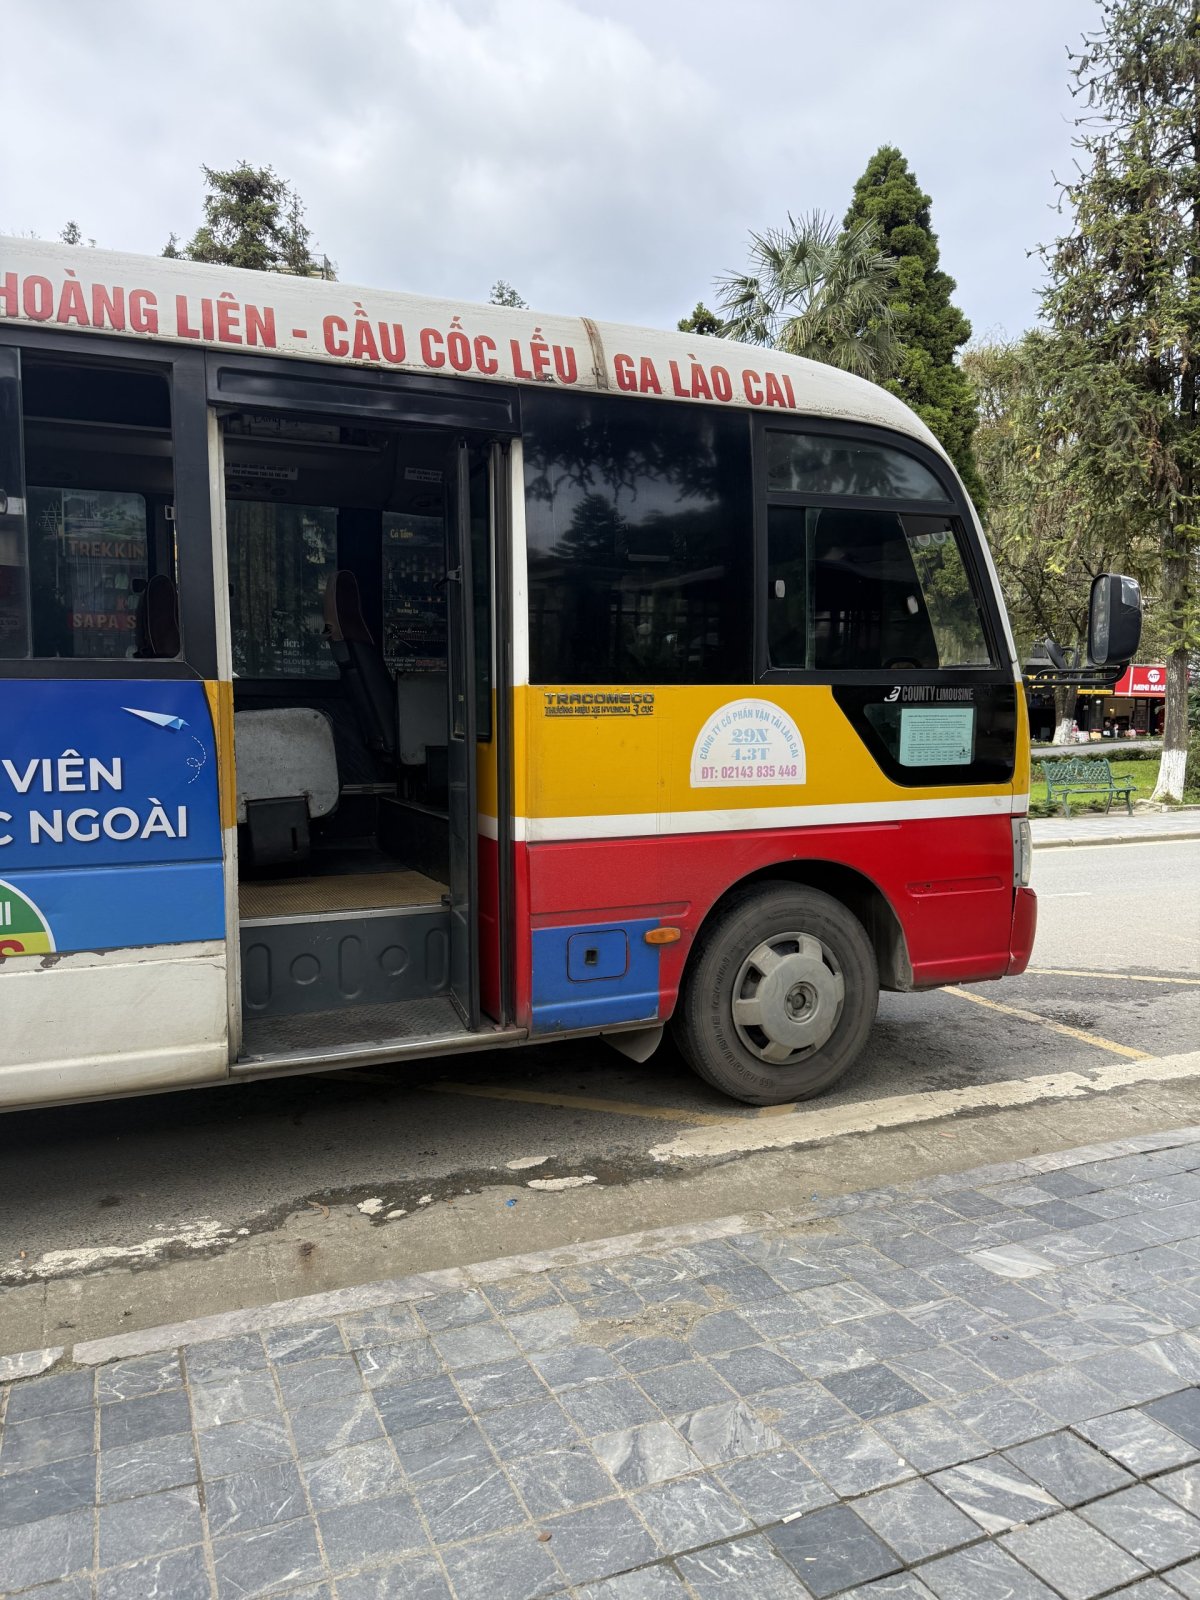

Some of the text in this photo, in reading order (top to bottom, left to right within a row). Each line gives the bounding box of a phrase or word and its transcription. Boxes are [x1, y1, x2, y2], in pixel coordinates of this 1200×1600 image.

[0, 268, 159, 334] HOÀNG
[176, 291, 277, 349] LIÊN
[322, 301, 406, 364] CẦU
[419, 315, 499, 375] CỐC
[509, 327, 578, 384] LẾU
[613, 353, 663, 395] GA
[668, 353, 733, 403] LÀO
[741, 369, 797, 409] CAI
[68, 540, 145, 558] TREKKIN
[902, 685, 974, 702] COUNTY LIMOUSINE
[1150, 684, 1166, 692] MAR
[544, 692, 655, 705] TRACOMECO
[731, 728, 769, 743] 29N
[731, 747, 770, 761] 4.3T
[1, 748, 123, 793] VIÊN
[701, 764, 798, 779] ĐT: 02143 835 448
[29, 797, 187, 844] NGOÀI
